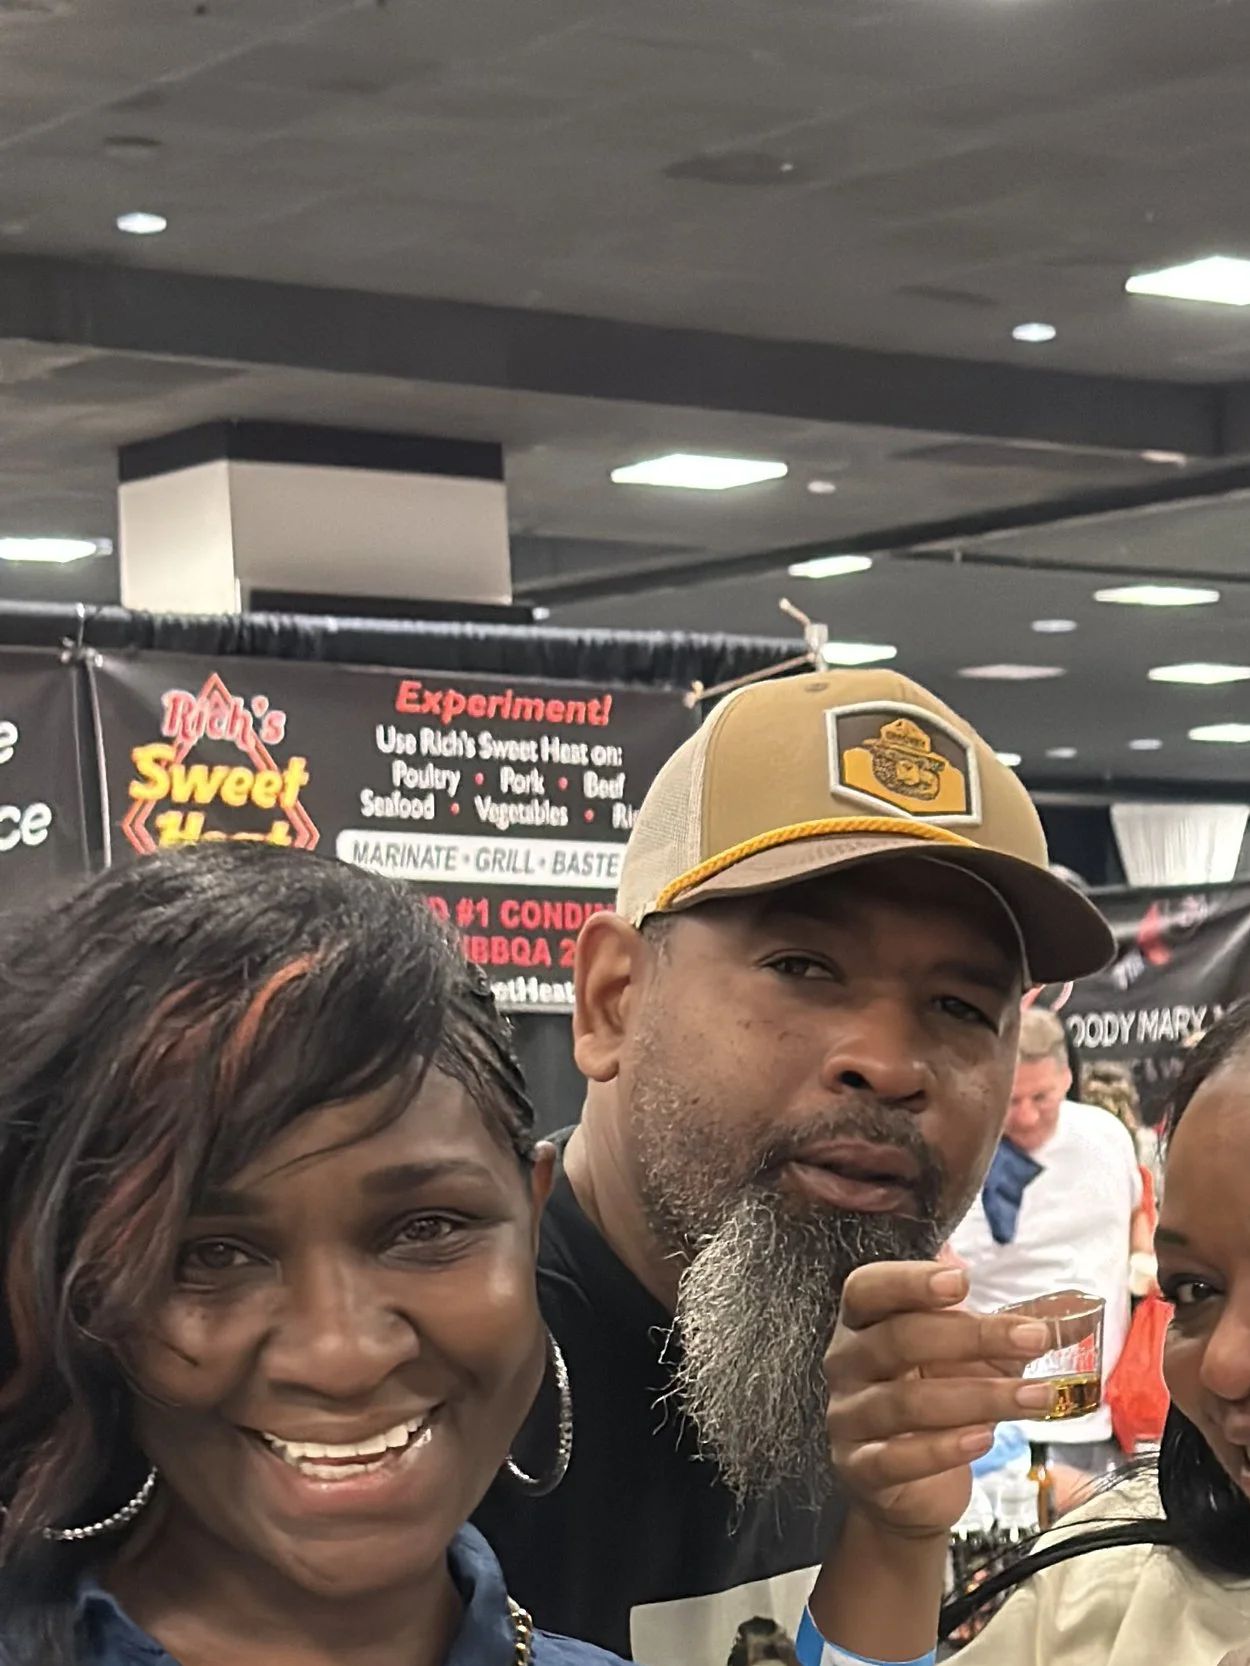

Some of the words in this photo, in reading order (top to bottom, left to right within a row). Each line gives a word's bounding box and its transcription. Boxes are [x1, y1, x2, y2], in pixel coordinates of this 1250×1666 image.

[161, 690, 287, 750] Rich's
[395, 680, 612, 725] Experiment!
[376, 724, 416, 755] Use
[420, 727, 476, 758] Rich's
[478, 731, 538, 763] Sweet
[541, 735, 588, 766] Heat
[591, 745, 623, 767] on:
[129, 743, 309, 809] Sweet
[392, 760, 460, 797] Poultry
[501, 766, 544, 795] Pork
[584, 771, 625, 799] Beef
[361, 789, 435, 820] Seafood
[475, 795, 568, 830] Vegetables
[352, 840, 458, 871] MARINATE
[476, 850, 535, 875] GRILL
[552, 852, 620, 878] BASTE
[456, 897, 488, 929] #1
[1137, 1004, 1207, 1043] MARY
